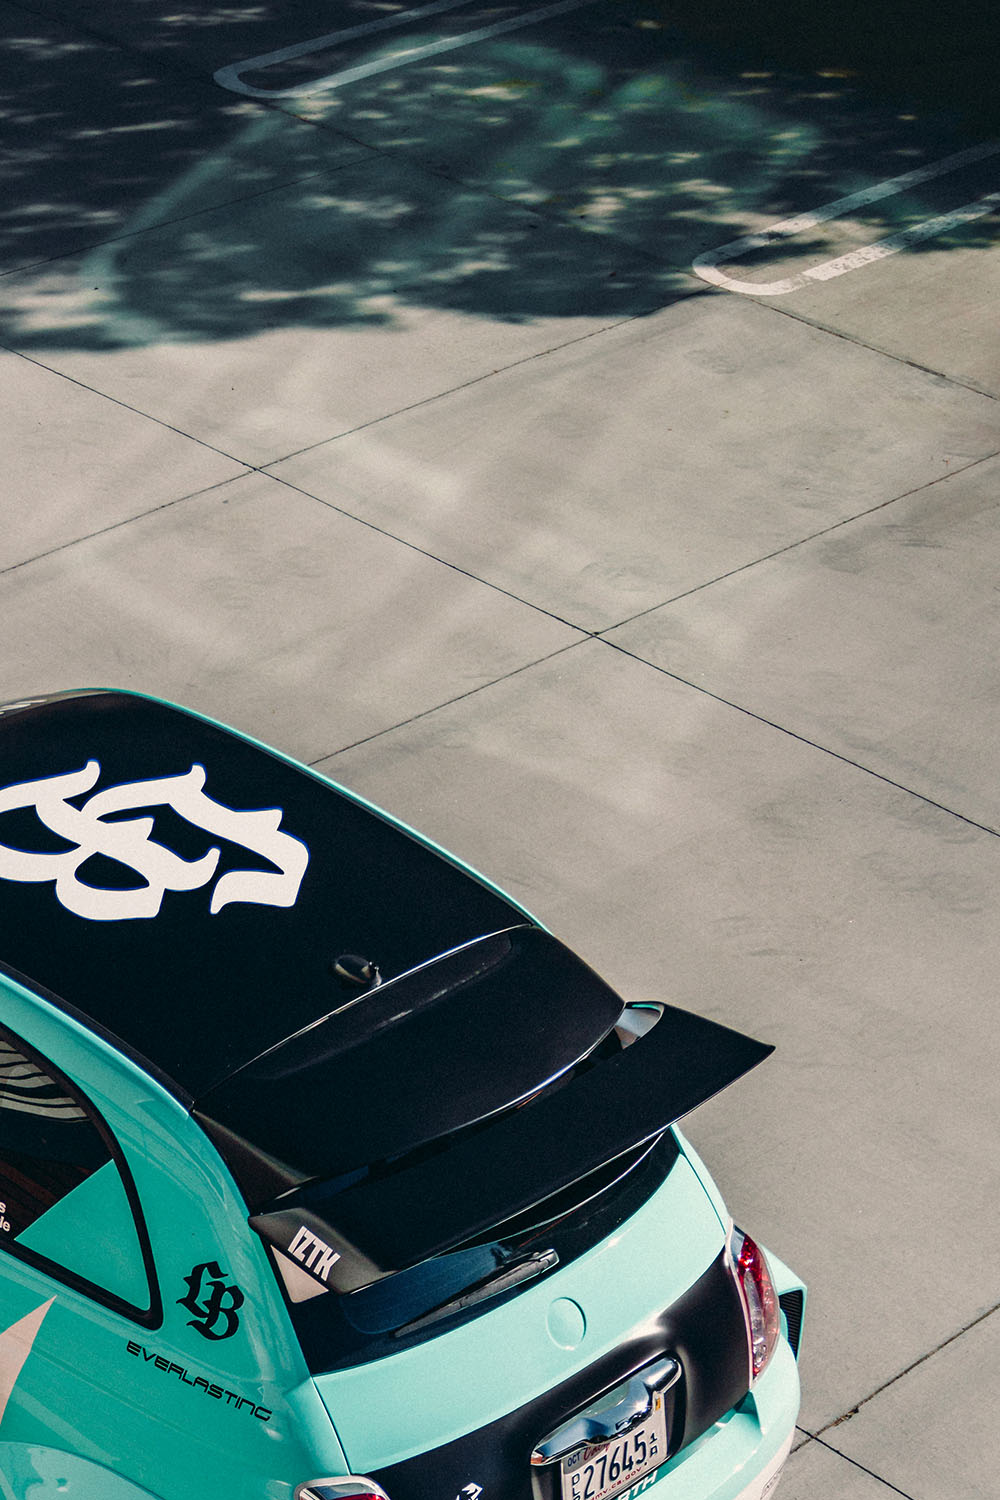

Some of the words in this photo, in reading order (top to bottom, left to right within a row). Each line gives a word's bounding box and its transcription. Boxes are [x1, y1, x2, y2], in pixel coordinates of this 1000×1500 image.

[287, 1225, 342, 1282] IZTK
[126, 1340, 273, 1421] EVERLASTING
[567, 1451, 581, 1467] OCT
[583, 1429, 647, 1500] 27645
